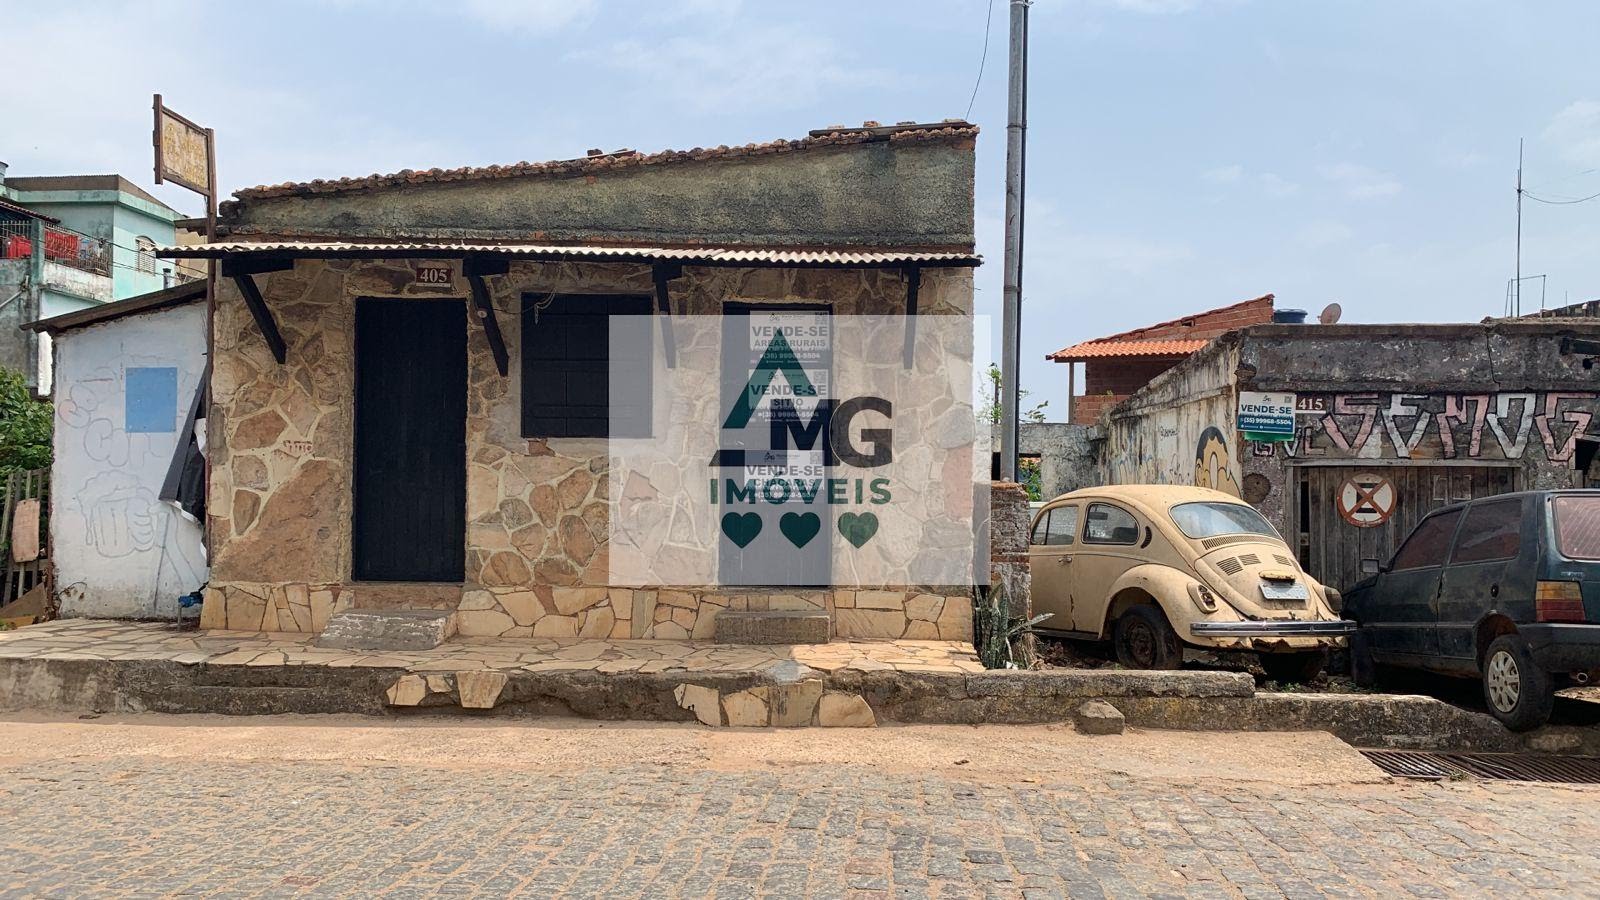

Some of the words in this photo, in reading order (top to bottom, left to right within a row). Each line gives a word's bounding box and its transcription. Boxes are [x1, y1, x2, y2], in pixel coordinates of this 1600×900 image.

[420, 268, 447, 283] 405
[752, 326, 828, 337] VENDE-SE
[751, 384, 827, 396] VENDE-SE
[1241, 404, 1292, 415] VENDE-SE
[1298, 398, 1323, 411] 415
[747, 465, 823, 476] VENDE-SE
